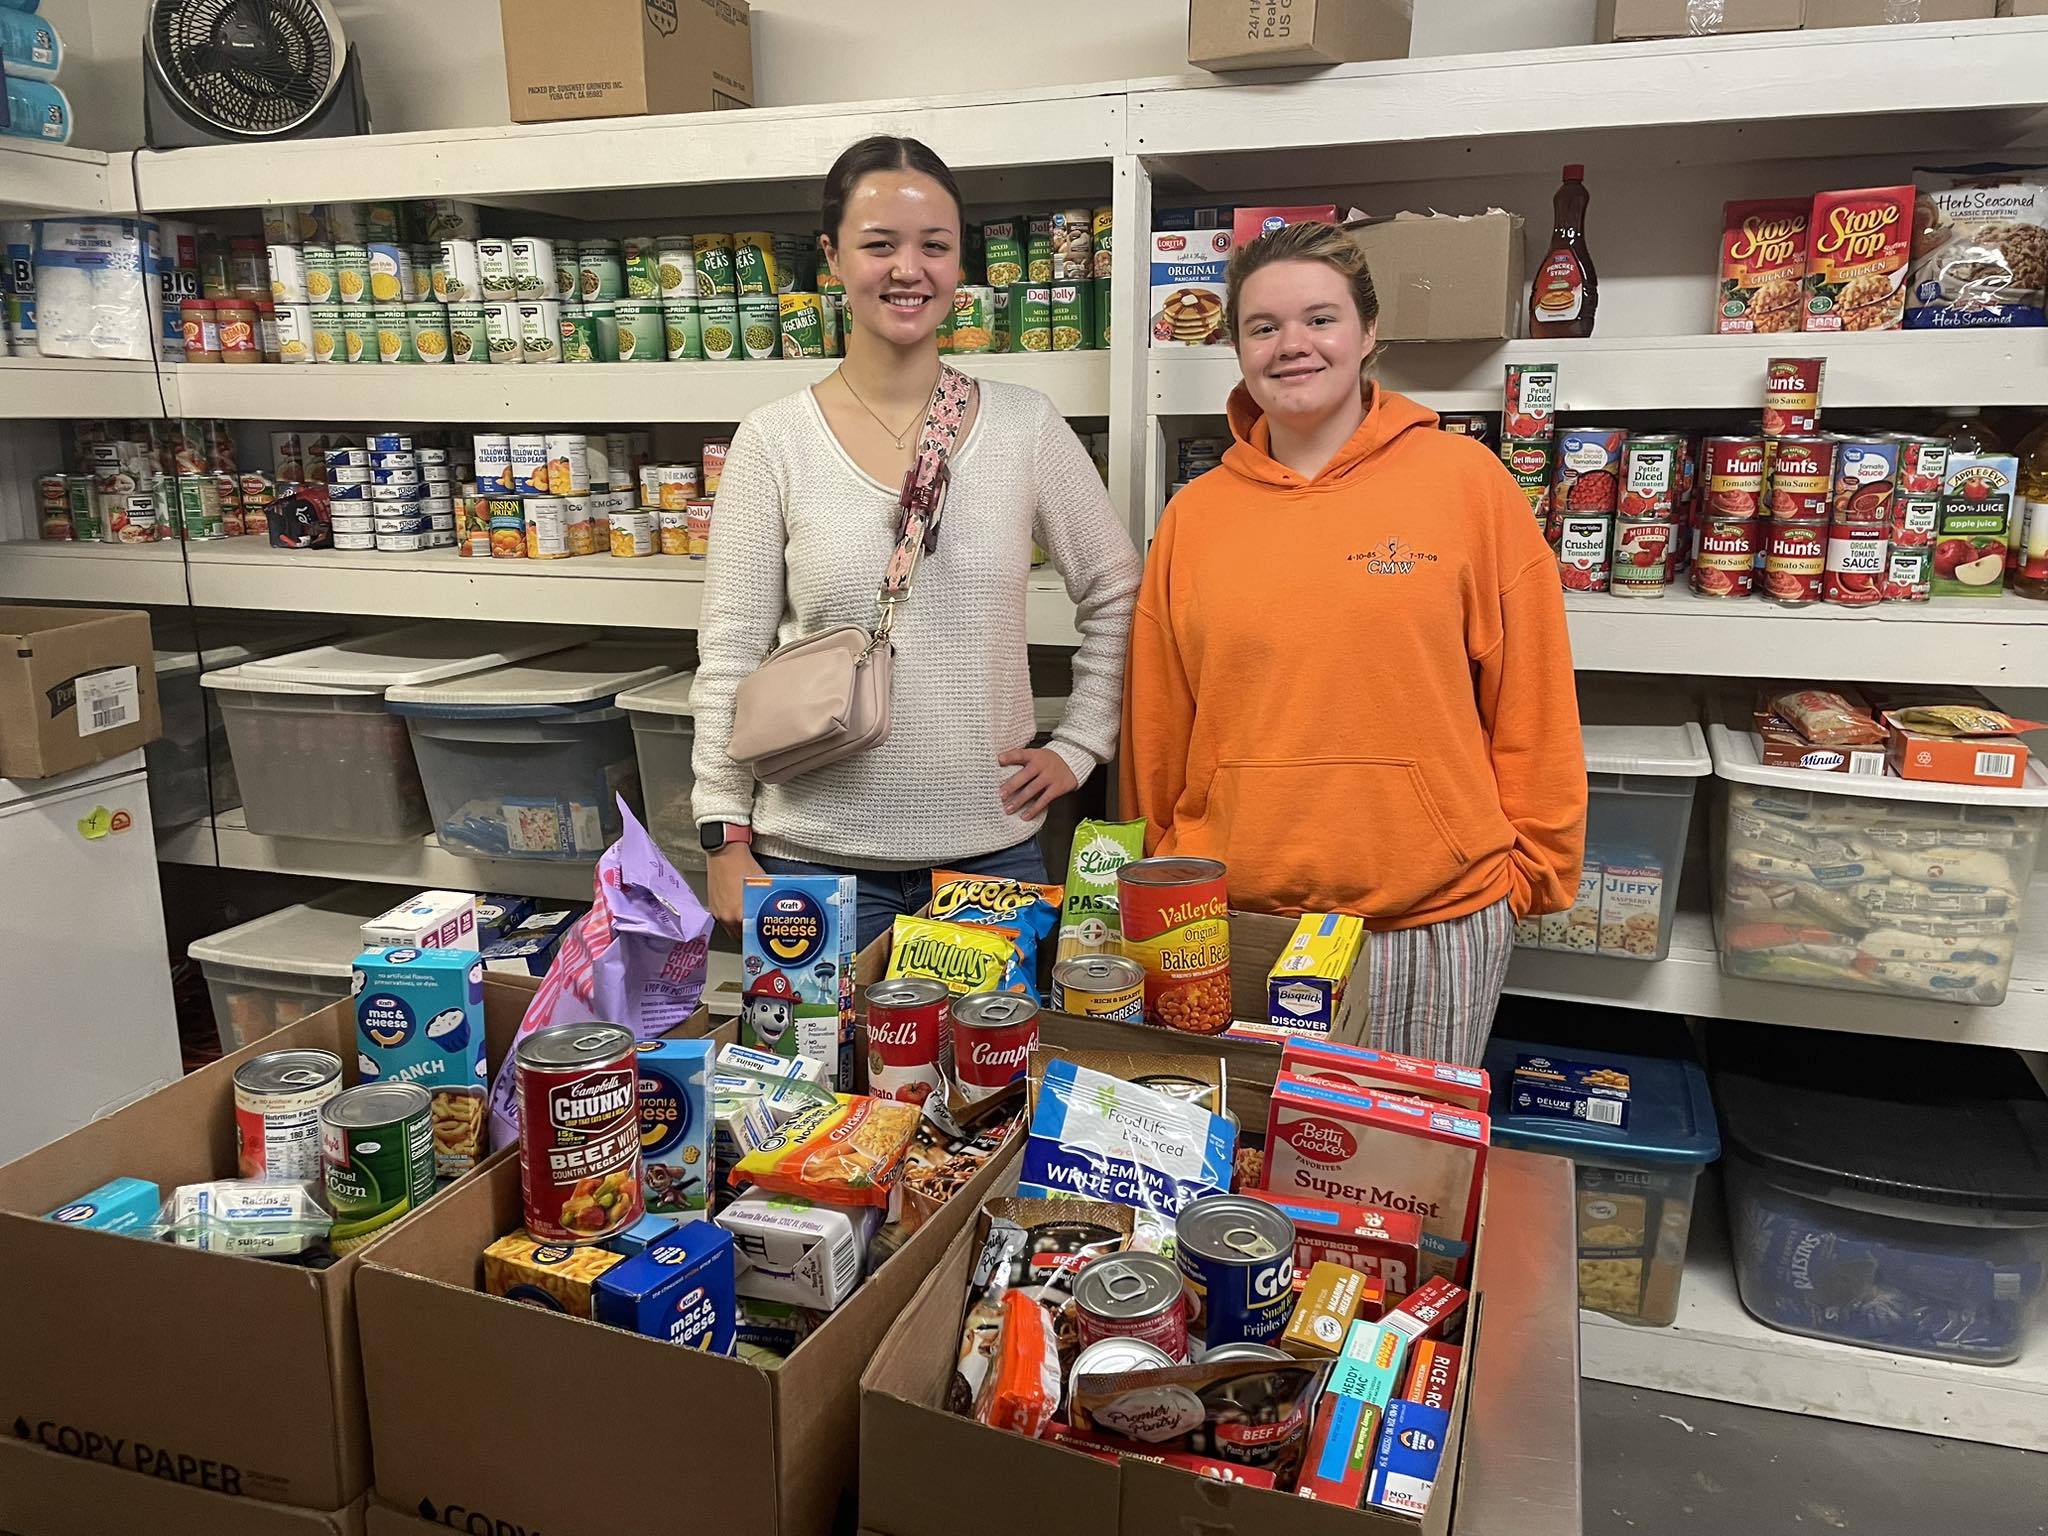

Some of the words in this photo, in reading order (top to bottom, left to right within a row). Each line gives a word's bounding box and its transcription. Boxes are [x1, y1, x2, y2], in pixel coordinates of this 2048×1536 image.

[1279, 14, 1291, 37] US
[1936, 195, 1972, 211] Herb
[1974, 192, 2035, 209] Seasoned
[1950, 209, 1980, 217] CLASSIC
[1981, 208, 2018, 216] STUFFING
[1731, 215, 1807, 260] Stove
[1817, 205, 1900, 253] Stove
[1158, 238, 1185, 249] LORETTA
[1217, 237, 1224, 246] 8
[1844, 232, 1887, 262] Top
[704, 255, 729, 269] PEAS
[1756, 240, 1795, 269] Top
[1168, 265, 1218, 276] ORIGINAL
[1751, 267, 1795, 285] CHICKEN
[1839, 260, 1887, 279] CHICKEN
[1932, 312, 1962, 326] Herb
[1963, 312, 2013, 326] Seasoned
[1527, 393, 1551, 402] Diced
[1513, 456, 1523, 464] Del
[1524, 456, 1544, 464] Monte
[1635, 472, 1663, 481] Diced
[1955, 468, 1982, 486] APPLE
[1989, 470, 2004, 485] EVE
[1946, 504, 1975, 513] 100%
[1975, 503, 2004, 513] JUICE
[1630, 526, 1651, 537] MUIR
[1950, 519, 1975, 528] apple
[1977, 518, 1998, 528] juice
[1565, 540, 1604, 550] Crushed
[1703, 536, 1750, 552] Hunt's
[1773, 540, 1821, 555] Hunt's
[1850, 542, 1877, 550] ORGANIC
[1367, 561, 1415, 574] CMW
[1842, 558, 1880, 569] SAUCE
[1801, 754, 1844, 766] Minute
[1606, 879, 1658, 896] JIFFY
[780, 901, 798, 910] Kraft
[1158, 901, 1209, 928] Valley
[763, 915, 809, 925] macaroni
[809, 917, 817, 925] &
[1184, 923, 1219, 943] Original
[897, 936, 992, 988] FUNYUNS
[1160, 944, 1206, 972] Baked
[1279, 990, 1321, 1004] Bisquick
[369, 1009, 393, 1019] mac
[394, 1010, 405, 1019] &
[1271, 1015, 1328, 1031] DISCOVER
[388, 1059, 445, 1083] RANCH
[571, 1075, 619, 1097] Campbell's
[555, 1083, 632, 1121] CHUNKY
[1369, 1090, 1394, 1102] Super
[1396, 1094, 1434, 1109] Moist
[1536, 1097, 1571, 1109] DELUXE
[265, 1111, 297, 1121] Nutrition
[299, 1108, 318, 1117] Facts
[1108, 1108, 1141, 1127] Food
[290, 1130, 303, 1140] 180
[306, 1127, 319, 1136] 320
[1302, 1122, 1344, 1148] Betty
[550, 1138, 615, 1171] BEEF
[617, 1121, 639, 1150] WITH
[1122, 1129, 1185, 1158] Balanced
[1291, 1133, 1351, 1159] Crocker
[552, 1166, 588, 1180] COUNTRY
[589, 1137, 640, 1172] VEGETABLES
[1296, 1155, 1342, 1172] FAVORITES
[1047, 1162, 1110, 1194] WHITE
[1090, 1157, 1163, 1190] PREMIUM
[328, 1177, 368, 1198] Corn
[1294, 1169, 1366, 1201] Super
[1371, 1186, 1441, 1218] Moist
[1354, 1228, 1389, 1239] HELPER
[1792, 1233, 1821, 1290] RAISINS
[682, 1292, 699, 1308] Kraft
[670, 1306, 701, 1335] mac
[701, 1298, 712, 1315] &
[1261, 1301, 1286, 1321] Small
[1243, 1318, 1280, 1338] Frijoles
[1430, 1355, 1451, 1386] RICE
[1355, 1376, 1369, 1397] MAC
[1107, 1403, 1170, 1424] Premier
[1128, 1413, 1183, 1434] Pantry
[1054, 1433, 1107, 1450] Potatoes
[1242, 1427, 1274, 1441] BEEF
[37, 1420, 126, 1466] COPY
[134, 1443, 242, 1496] PAPER
[1389, 1490, 1414, 1499] NOT
